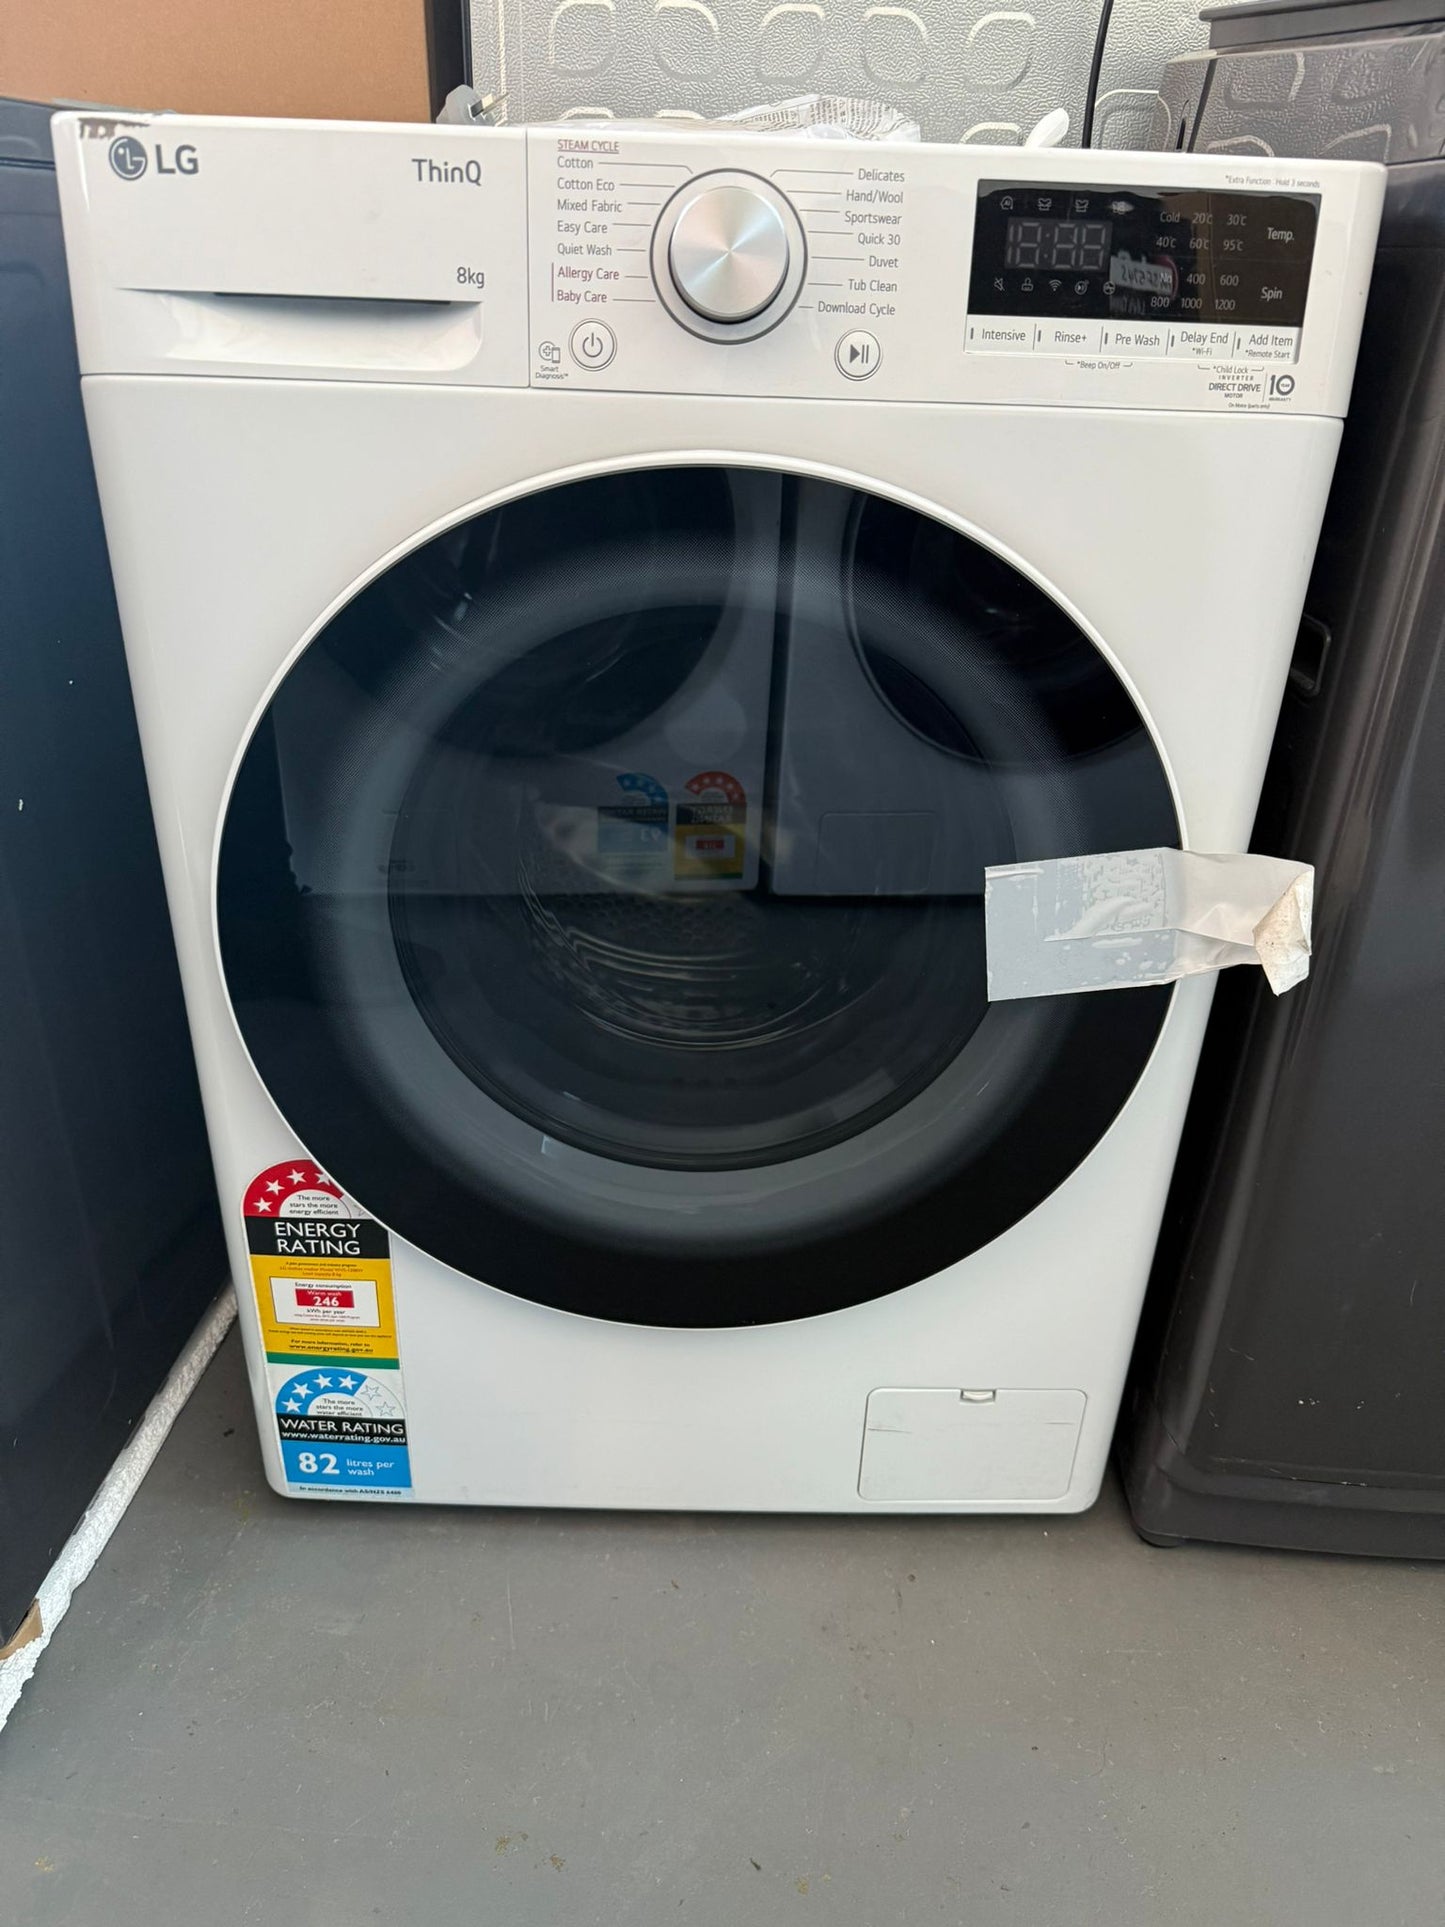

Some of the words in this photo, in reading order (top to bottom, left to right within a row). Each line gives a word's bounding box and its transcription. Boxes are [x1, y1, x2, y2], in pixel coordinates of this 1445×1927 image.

[557, 139, 589, 151] STEAM
[591, 140, 620, 152] CYCLE
[155, 144, 199, 175] LG
[557, 156, 594, 169] Cotton
[411, 158, 482, 187] ThinQ
[858, 168, 905, 182] Delicates
[557, 177, 593, 190] Cotton
[596, 178, 615, 191] Eco
[846, 190, 904, 204] Hand/Wool
[557, 198, 588, 211] Mixed
[591, 200, 623, 213] Fabric
[844, 210, 902, 226] Sportswear
[1160, 211, 1181, 223] Cold
[557, 220, 581, 236] Easy
[584, 221, 608, 234] Care
[858, 232, 884, 246] Quick
[888, 234, 901, 246] 30
[1267, 227, 1295, 244] Temp.
[557, 242, 583, 256] Quiet
[586, 244, 612, 256] Wash
[869, 256, 899, 268] Duvet
[456, 266, 485, 289] 8kg
[558, 266, 593, 282] Allergy
[596, 268, 620, 280] Care
[1186, 274, 1206, 285] 400
[1220, 274, 1240, 286] 600
[848, 278, 866, 291] Tub
[870, 280, 898, 292] Clean
[557, 290, 582, 304] Baby
[584, 290, 608, 303] Care
[1260, 286, 1283, 302] Spin
[818, 300, 866, 314] Download
[869, 303, 896, 318] Cycle
[1150, 296, 1170, 308] 800
[1181, 298, 1203, 309] 1000
[1214, 299, 1236, 310] 1200
[981, 328, 1026, 341] Intensive
[1054, 331, 1087, 344] Rinse+
[1115, 333, 1132, 345] Pre
[1134, 334, 1160, 346] Wash
[1180, 331, 1207, 346] Delay
[1210, 332, 1229, 344] End
[1249, 334, 1268, 346] Add
[1272, 335, 1294, 347] Item
[1273, 351, 1290, 360] Start
[540, 365, 559, 373] Smart
[1098, 361, 1122, 370] On/Off
[1234, 366, 1249, 375] Lock
[1208, 382, 1238, 392] DIRECT
[1238, 383, 1262, 392] DRIVE
[274, 1222, 360, 1238] ENERGY
[276, 1239, 361, 1255] RATING
[312, 1296, 340, 1306] 246
[280, 1418, 338, 1432] WATER
[342, 1421, 404, 1434] RATING
[281, 1432, 406, 1444] www.waterrating.gov.au
[298, 1452, 340, 1475] 82
[346, 1458, 373, 1468] litres
[376, 1460, 395, 1470] per
[348, 1468, 375, 1476] wash
